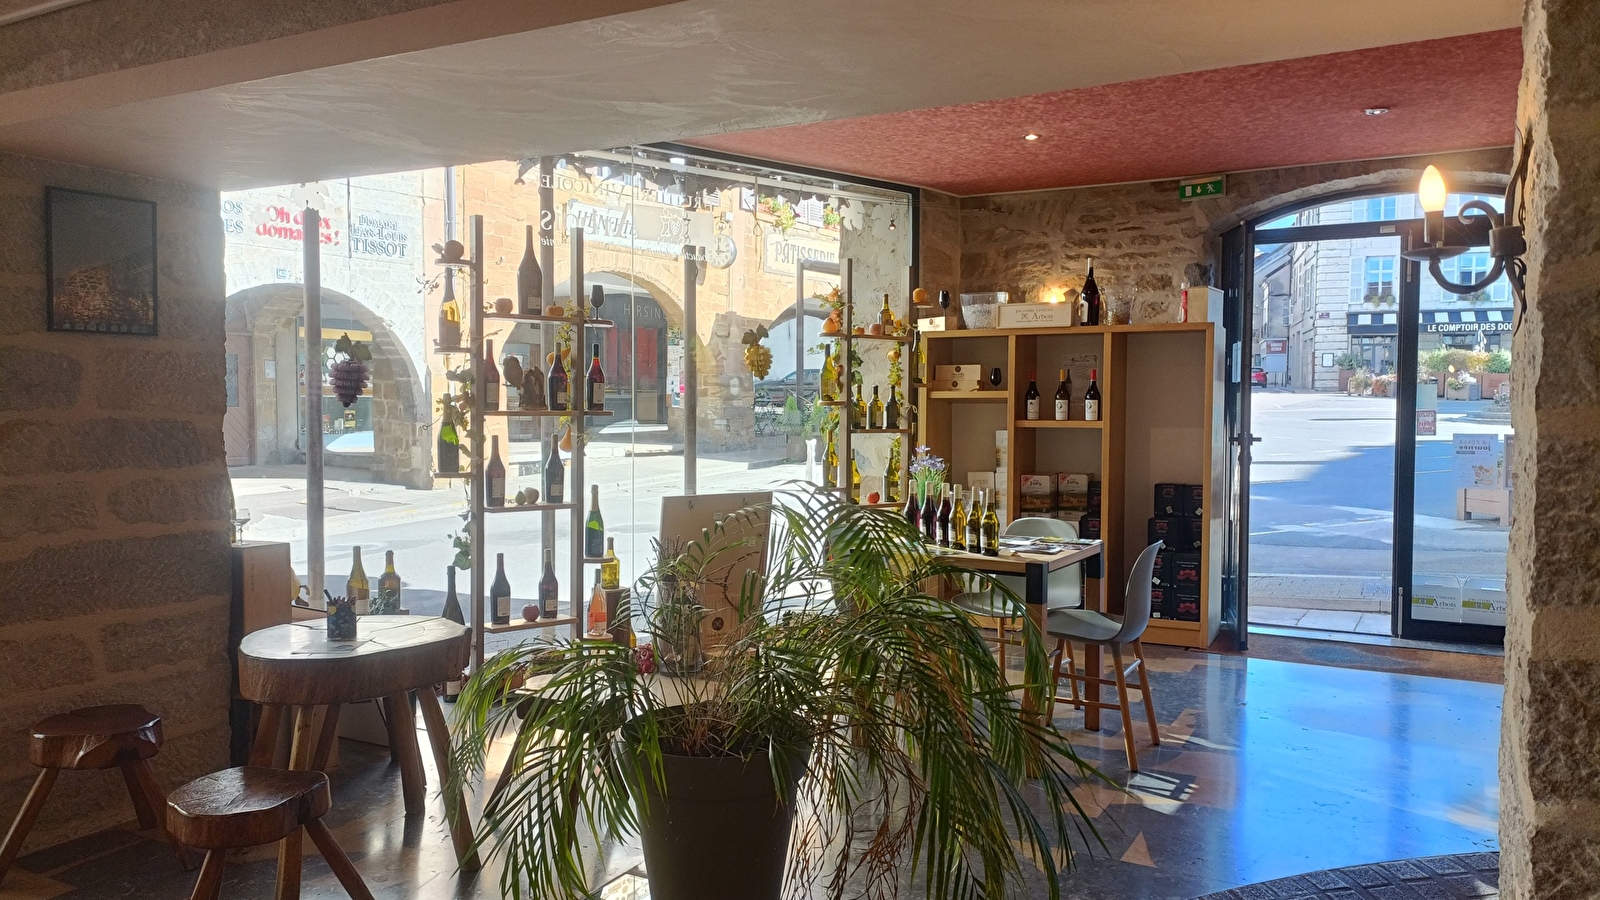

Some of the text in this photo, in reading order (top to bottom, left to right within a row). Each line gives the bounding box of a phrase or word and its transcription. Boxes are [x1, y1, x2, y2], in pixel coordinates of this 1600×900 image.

[358, 214, 400, 231] DOMAINE
[352, 237, 408, 258] TISSOT
[623, 303, 667, 319] HRSIN
[1032, 312, 1054, 320] Arbois
[1427, 324, 1437, 332] LE
[1438, 323, 1479, 332] COMPTOIR
[1480, 323, 1496, 331] DES
[1433, 598, 1457, 608] Arbois
